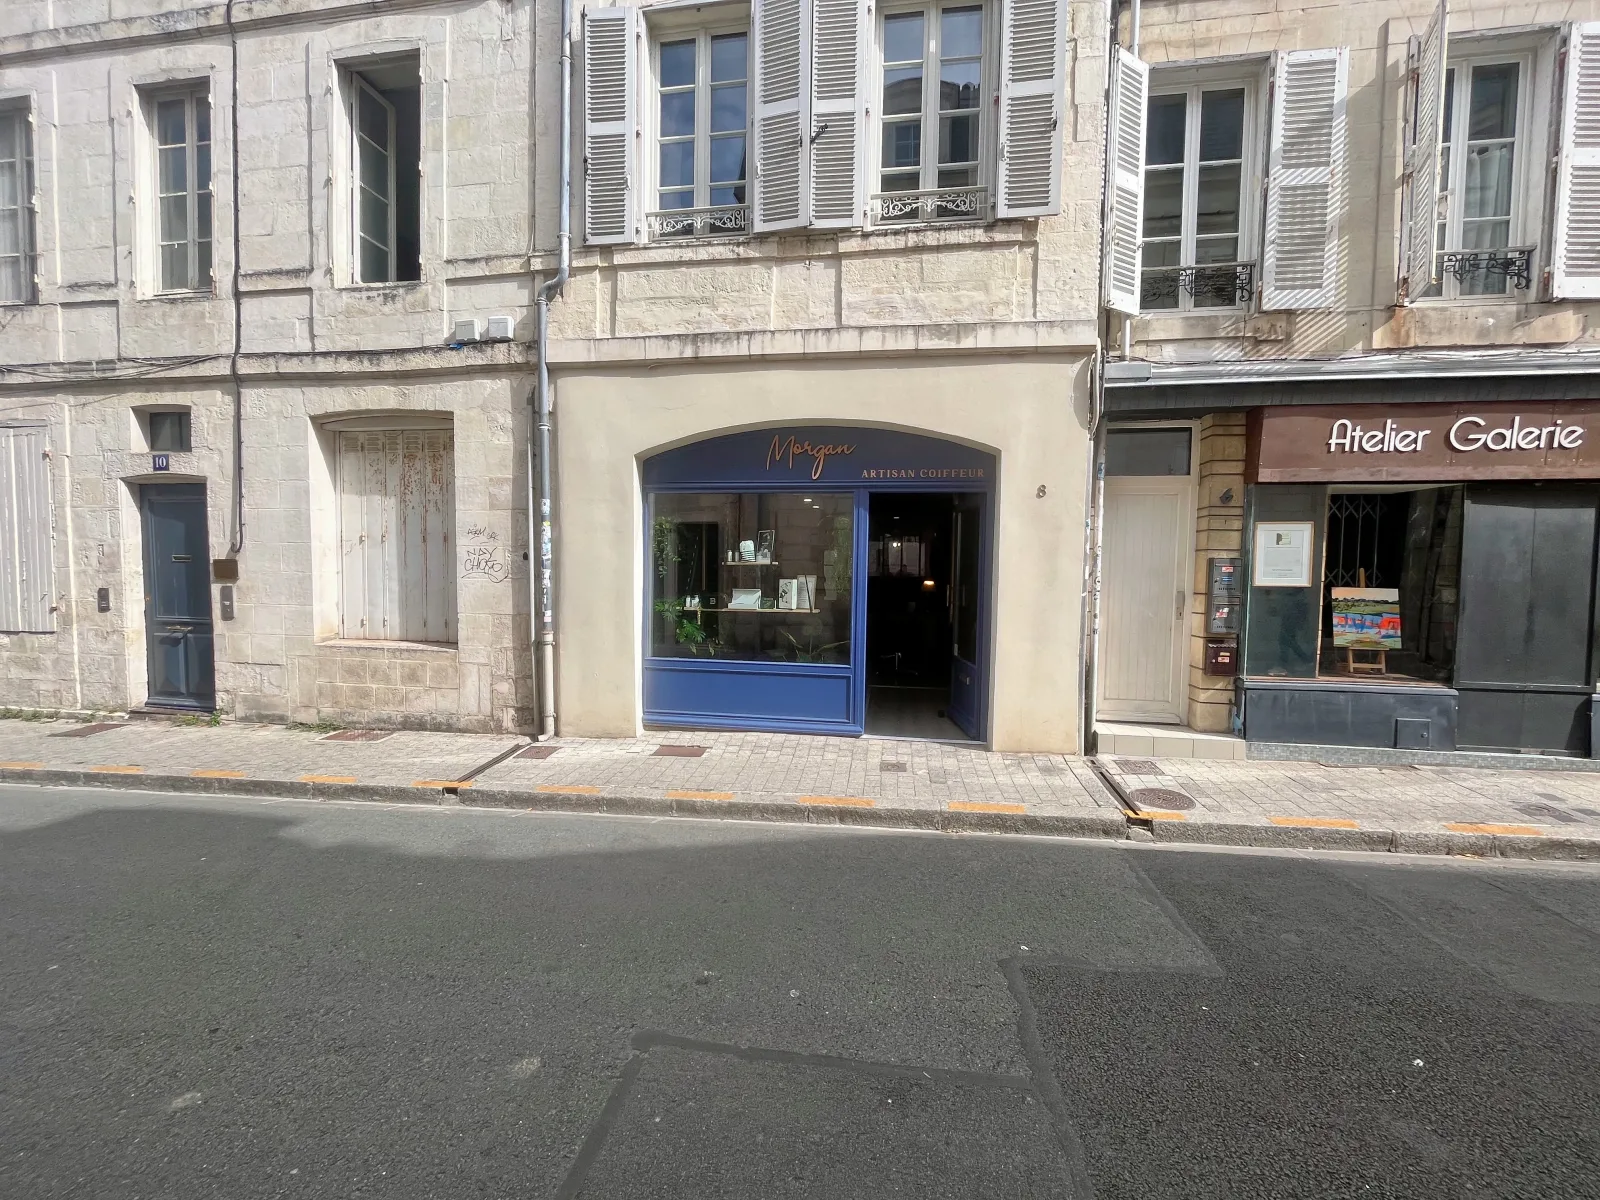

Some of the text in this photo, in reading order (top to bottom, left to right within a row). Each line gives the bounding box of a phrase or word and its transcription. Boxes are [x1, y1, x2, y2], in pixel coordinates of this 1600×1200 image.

[1328, 416, 1584, 452] Atelier Galerie
[155, 456, 167, 468] 10
[766, 434, 857, 480] Morgan
[861, 468, 985, 479] ARTISAN COIFFEUR
[1035, 484, 1047, 499] 8
